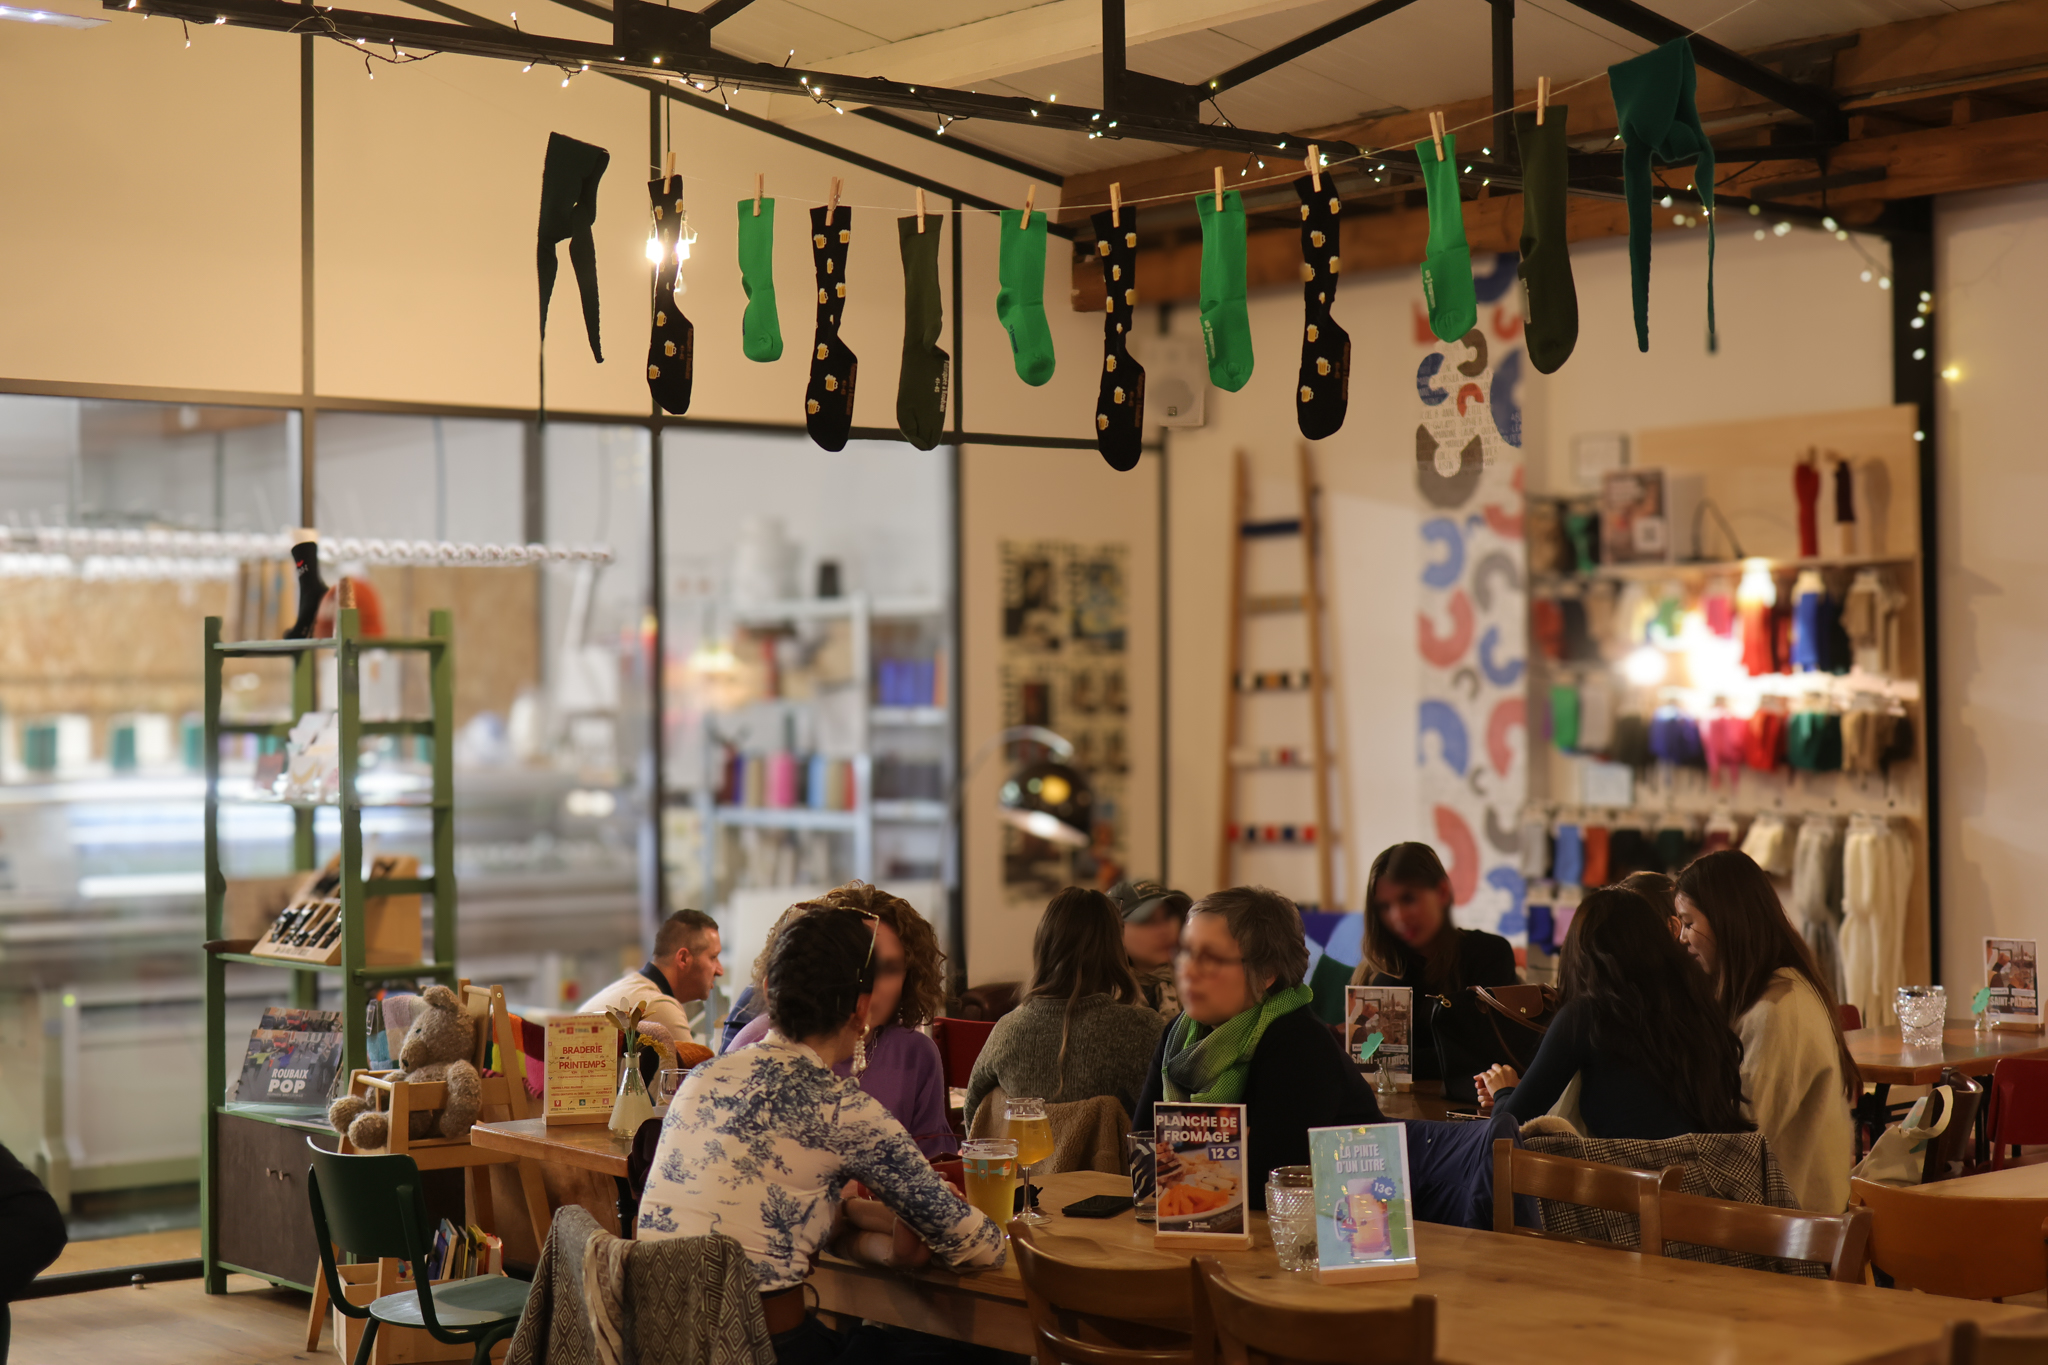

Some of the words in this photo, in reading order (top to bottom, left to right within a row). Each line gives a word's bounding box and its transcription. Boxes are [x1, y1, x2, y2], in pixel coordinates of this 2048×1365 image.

[562, 1045, 602, 1054] BRADERIE
[559, 1060, 606, 1069] PRINTEMPS
[271, 1068, 309, 1079] ROUBAIX
[267, 1079, 306, 1094] POP
[1155, 1115, 1217, 1128] PLANCHE
[1220, 1116, 1237, 1128] DE
[1164, 1130, 1230, 1143] FROMAGE
[1210, 1147, 1225, 1160] 12
[1226, 1147, 1238, 1159] €
[1339, 1145, 1351, 1159] LA
[1354, 1144, 1380, 1158] PINTE
[1336, 1160, 1359, 1174] D'UN
[1360, 1158, 1386, 1173] LITRE
[1374, 1182, 1393, 1196] 13€
